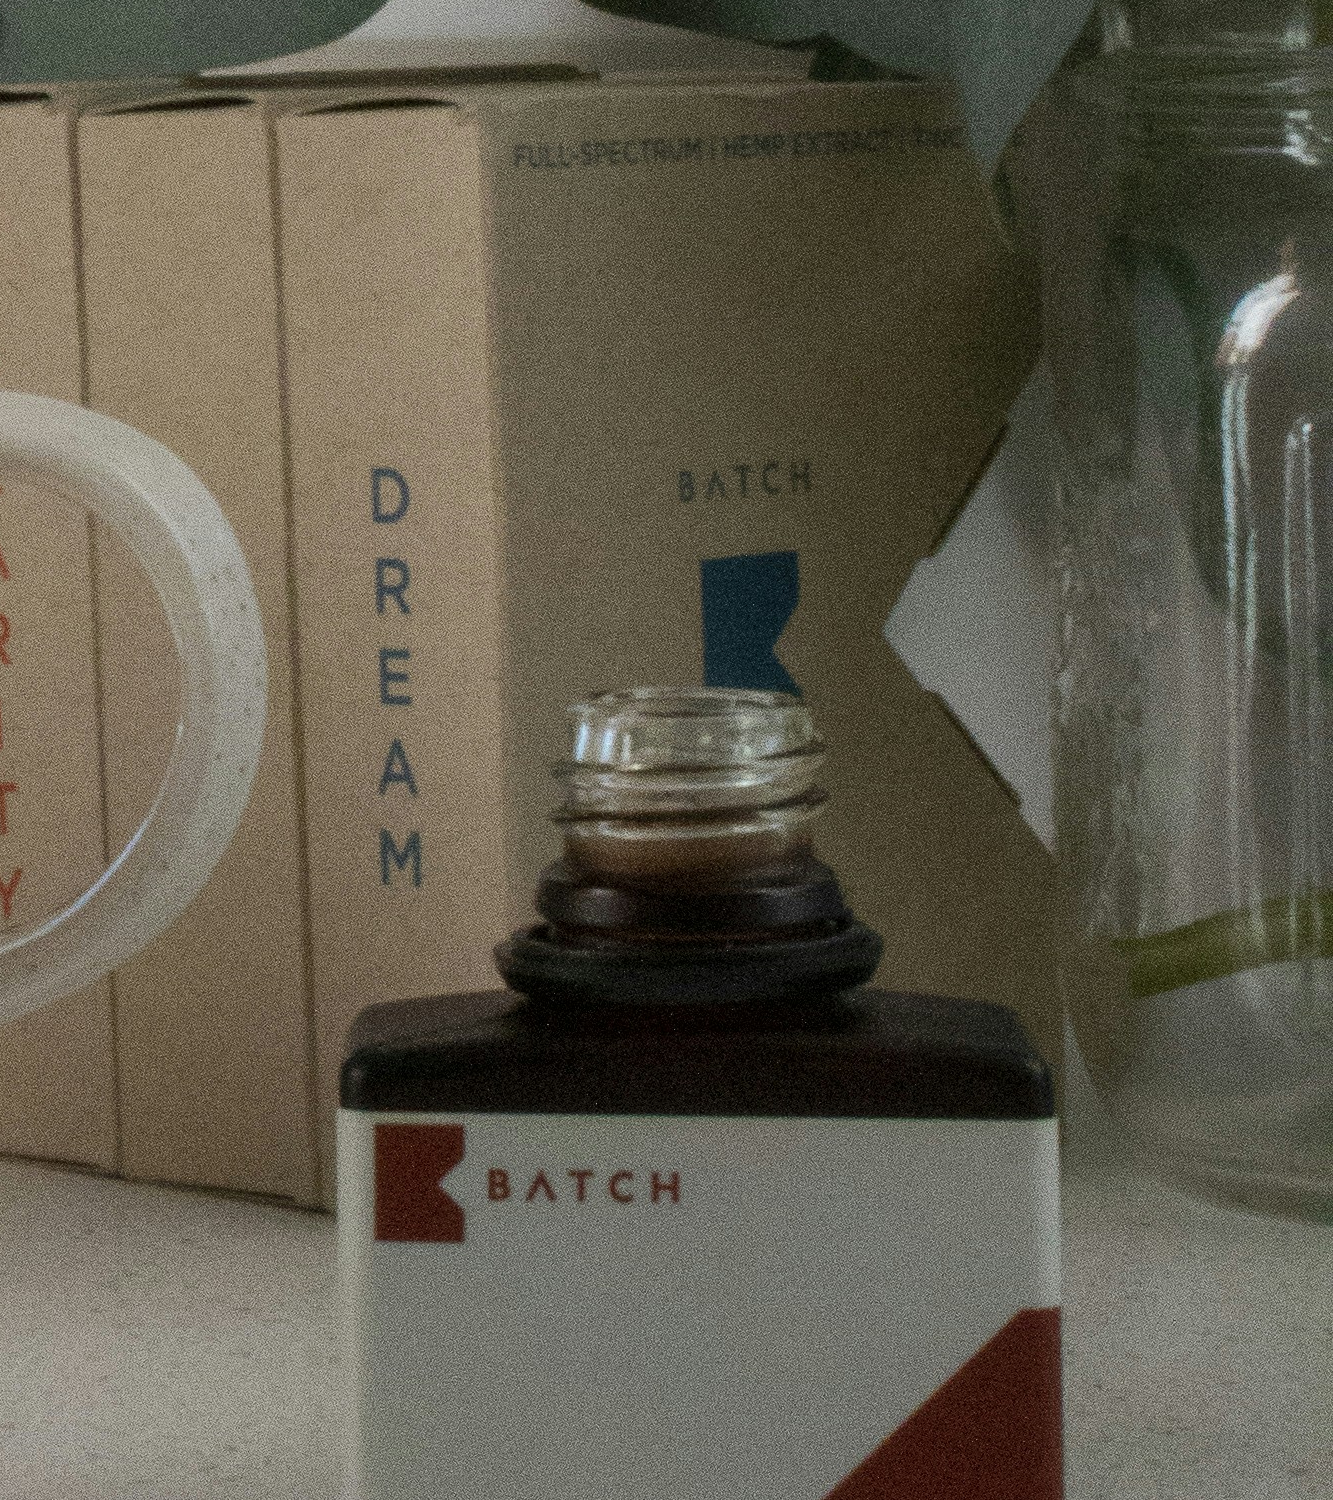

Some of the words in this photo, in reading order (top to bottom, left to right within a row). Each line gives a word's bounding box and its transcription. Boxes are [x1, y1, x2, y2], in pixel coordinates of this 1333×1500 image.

[676, 460, 813, 503] BATCH
[370, 466, 423, 888] DREAM
[487, 1167, 681, 1204] BATCH
